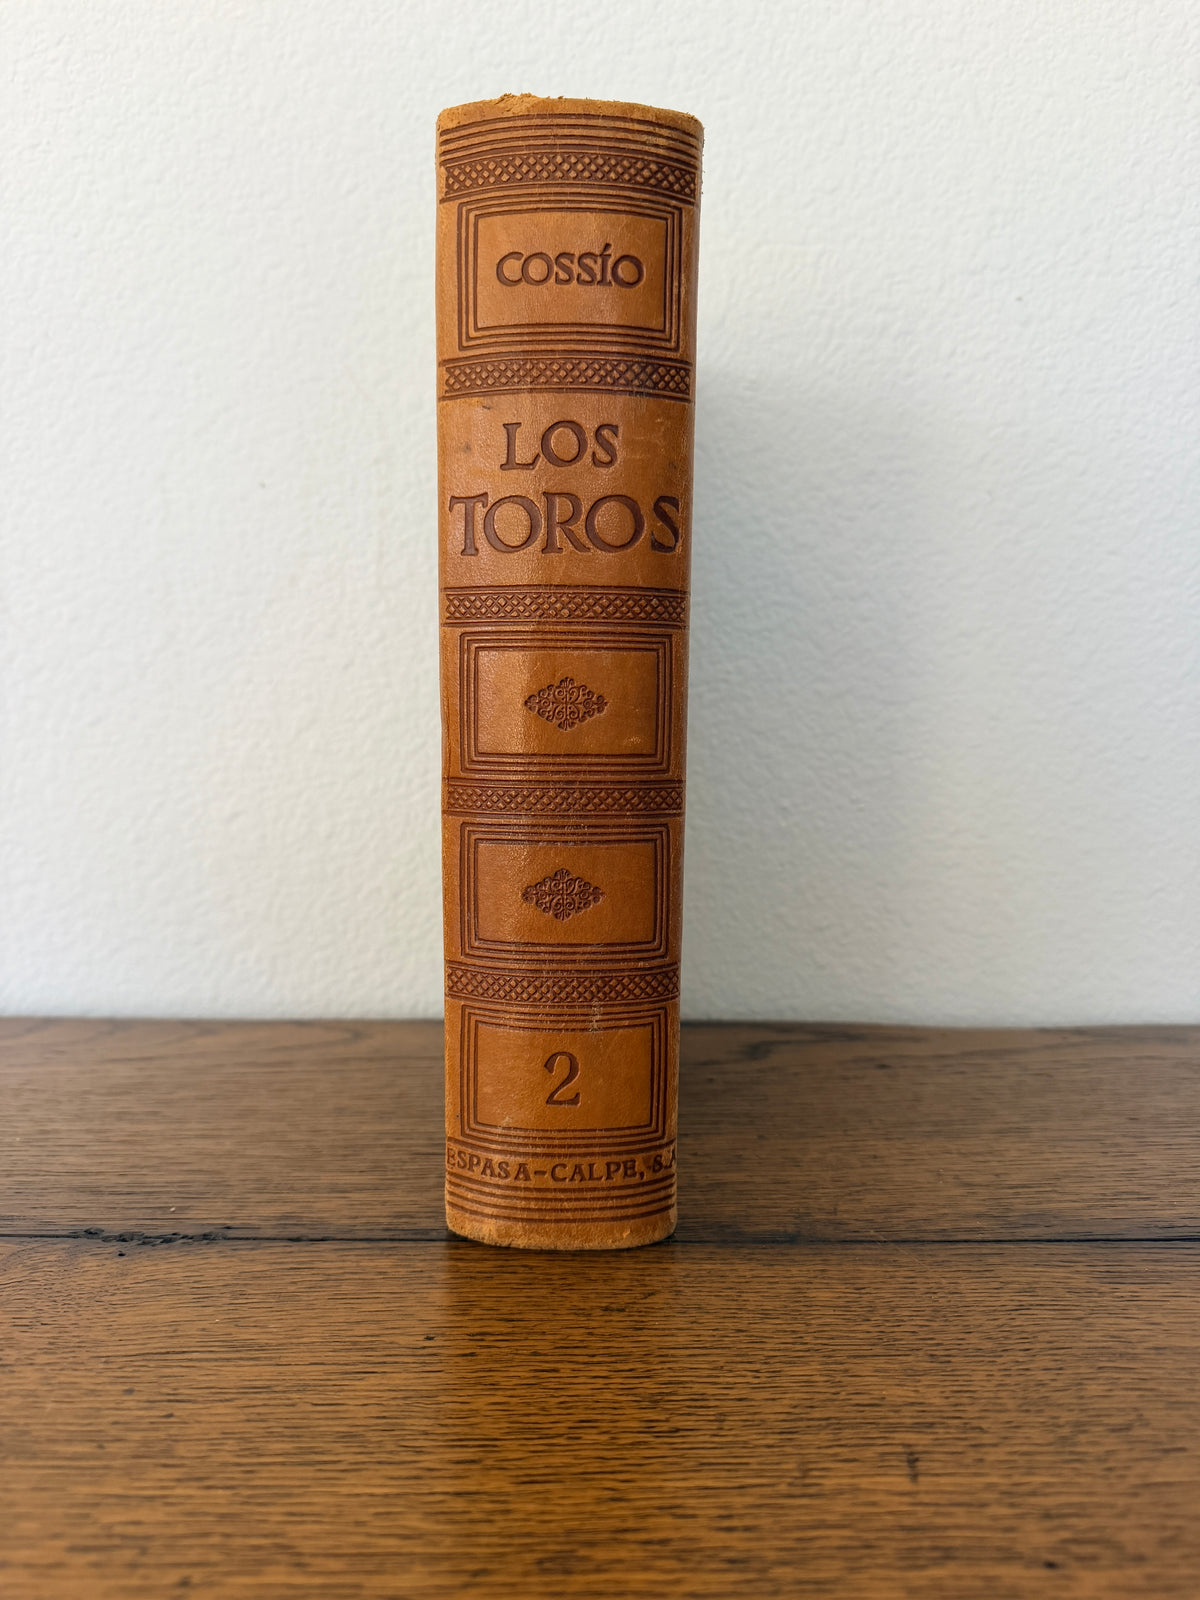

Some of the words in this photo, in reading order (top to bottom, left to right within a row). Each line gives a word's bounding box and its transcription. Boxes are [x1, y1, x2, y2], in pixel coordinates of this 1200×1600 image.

[496, 243, 644, 288] COSSÍO
[500, 420, 618, 470] LOS
[449, 492, 680, 556] TOROS
[543, 1051, 581, 1106] 2
[447, 1147, 645, 1182] ESPASA-CALPE,
